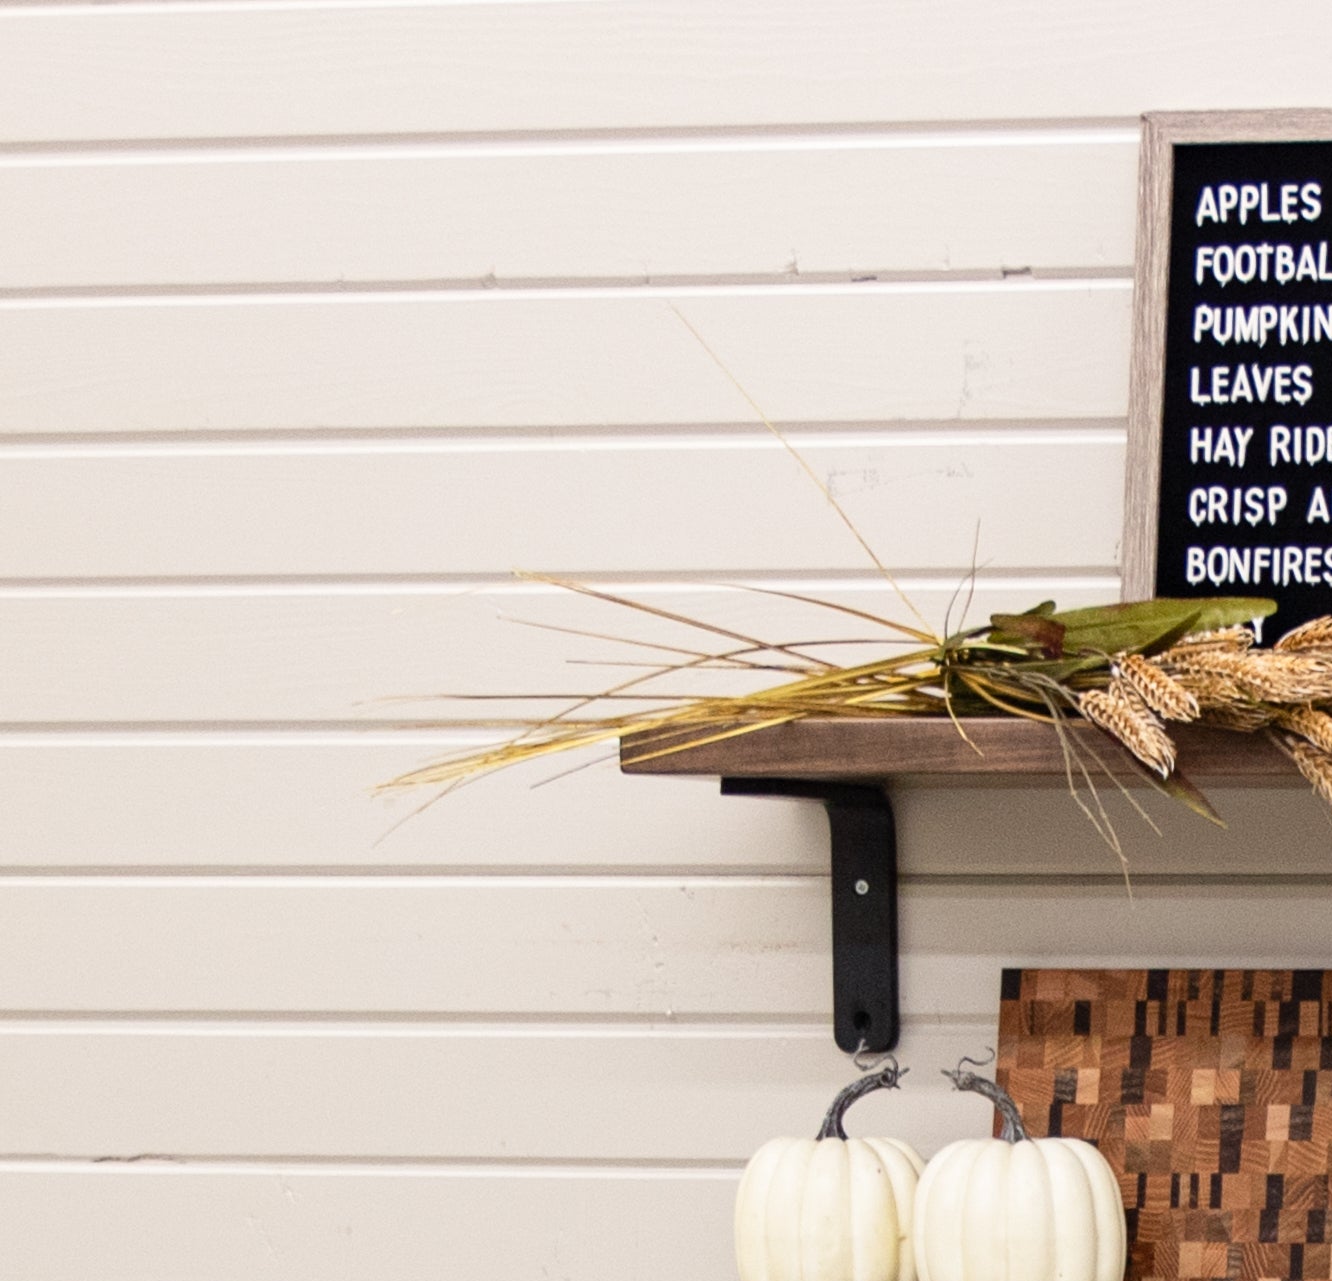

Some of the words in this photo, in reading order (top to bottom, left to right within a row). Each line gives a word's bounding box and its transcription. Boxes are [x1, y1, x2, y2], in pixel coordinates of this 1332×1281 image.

[1196, 184, 1322, 227] APPLES
[1191, 364, 1313, 406] LEAVES
[1191, 427, 1254, 467] HAY
[1190, 486, 1288, 526] CRISP
